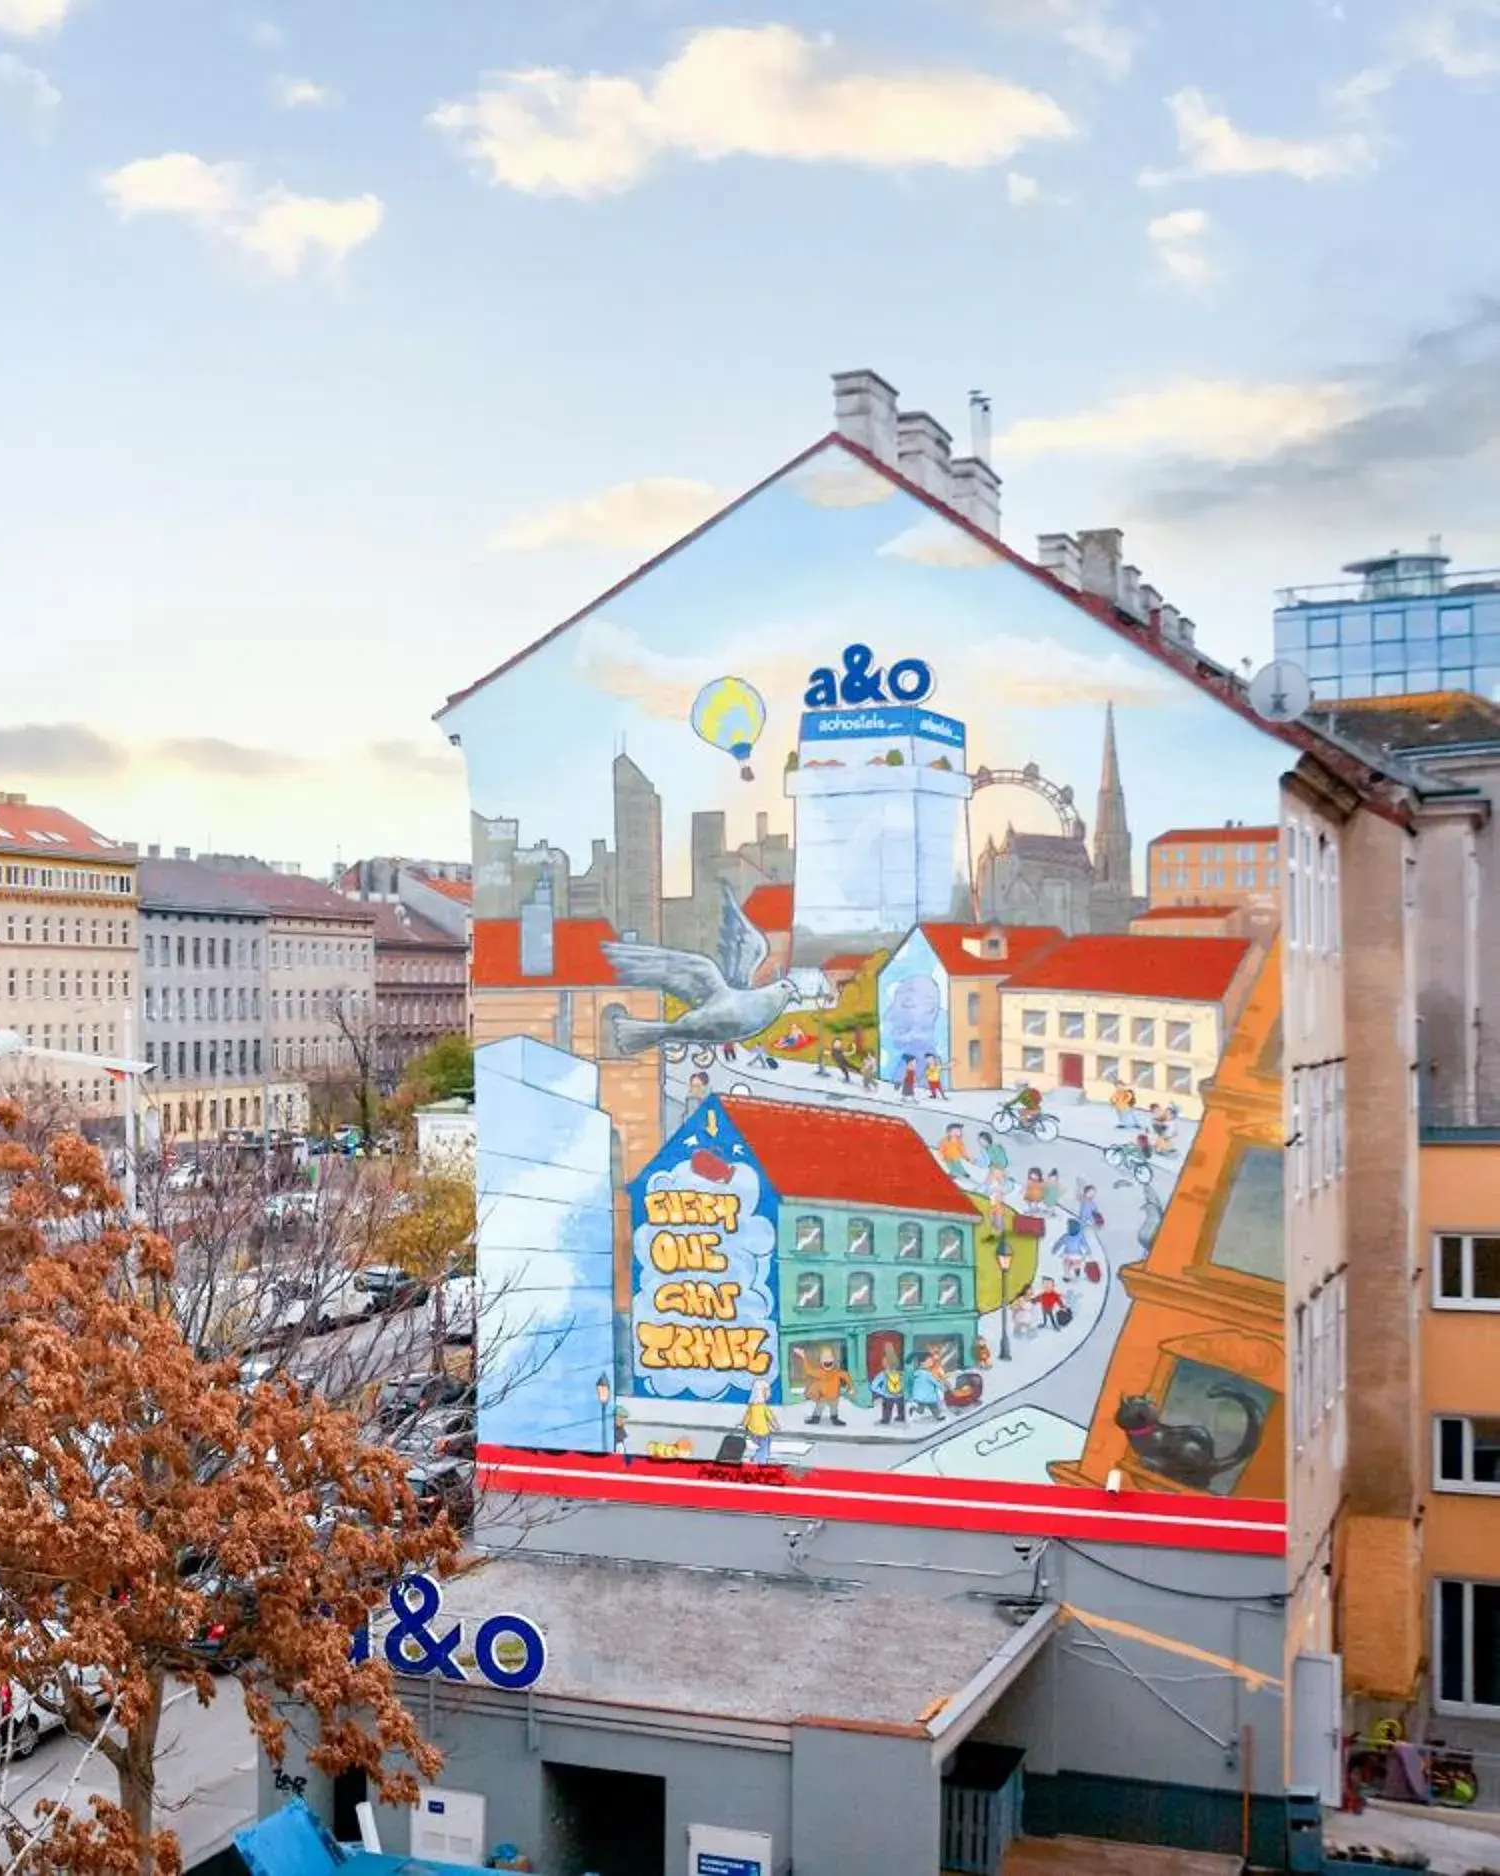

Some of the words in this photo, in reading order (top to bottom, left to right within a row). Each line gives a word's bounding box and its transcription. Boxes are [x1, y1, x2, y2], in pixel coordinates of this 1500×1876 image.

[804, 643, 933, 708] a&o
[651, 1230, 728, 1274] ONE
[654, 1280, 740, 1320] CAN
[636, 1322, 773, 1376] TRAVEL
